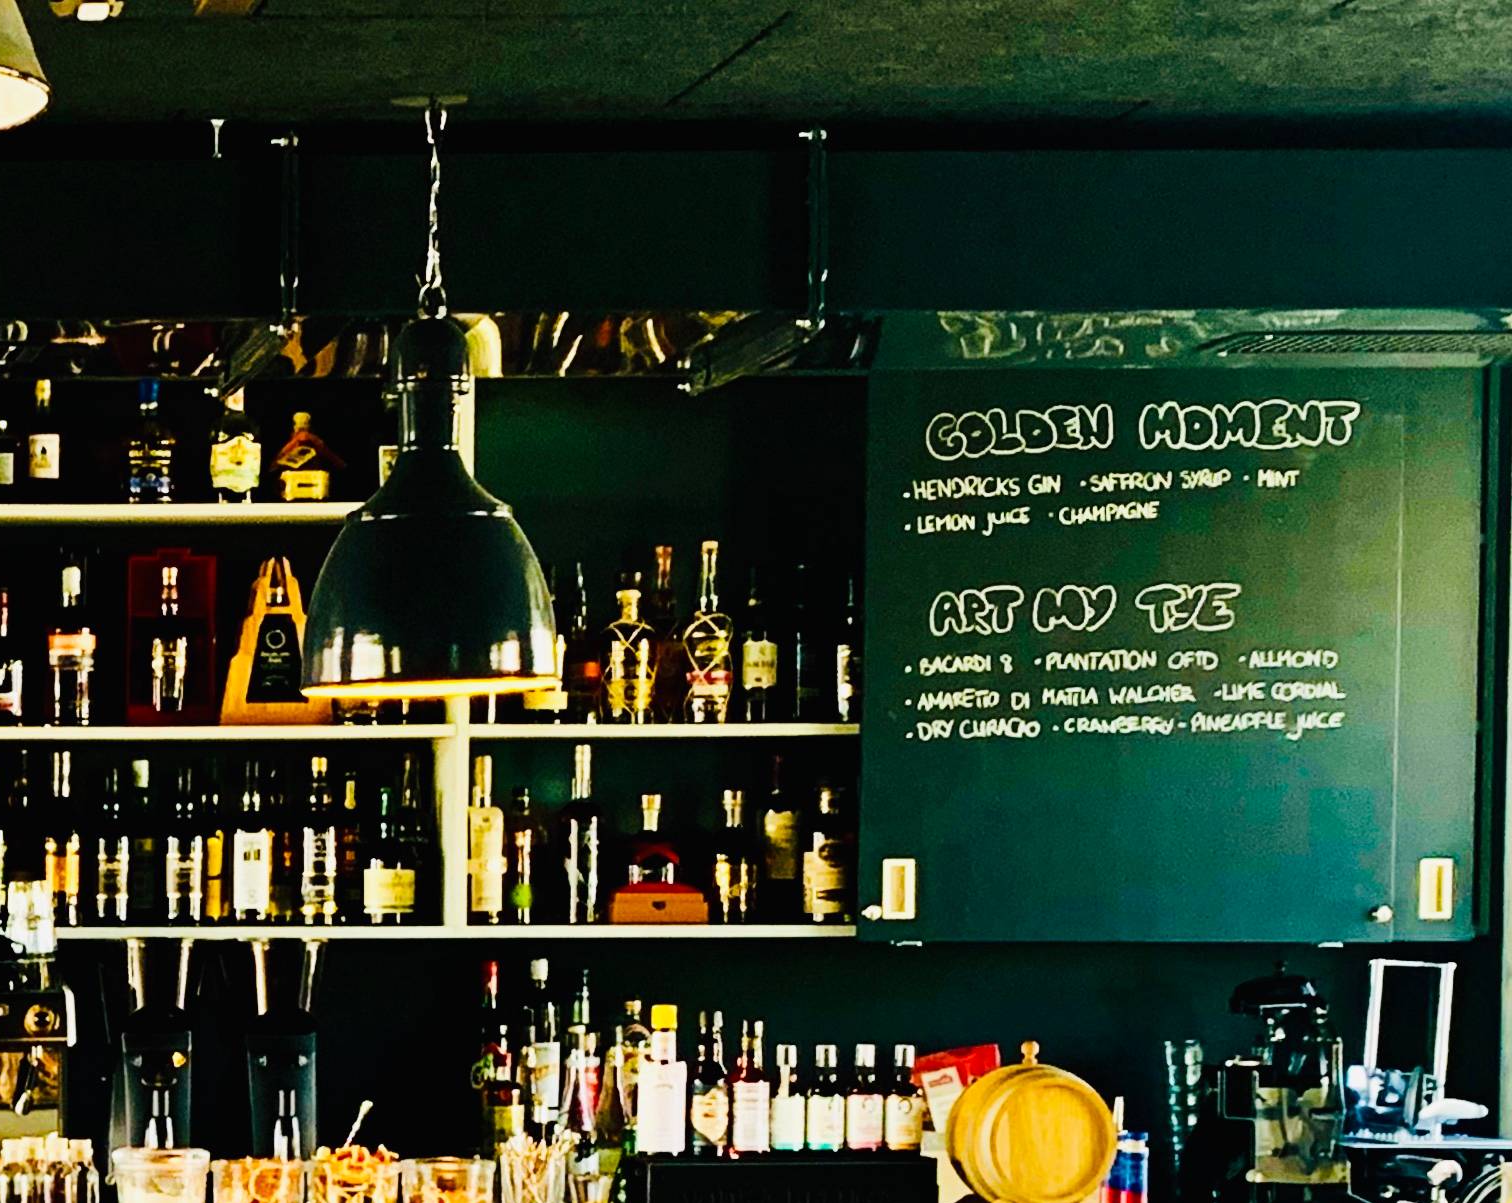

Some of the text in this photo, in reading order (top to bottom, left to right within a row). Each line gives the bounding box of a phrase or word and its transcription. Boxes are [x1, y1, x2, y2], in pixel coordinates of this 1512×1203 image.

[925, 398, 1361, 461] GOLDEN MOMENT
[912, 468, 1300, 501] HENDRICKS GIN SAFFRON SYRUP MINT
[917, 513, 976, 535] LEMON
[1058, 500, 1160, 526] CHAMPAGNE
[929, 584, 1025, 637] ART
[1032, 584, 1117, 633] MY
[919, 654, 992, 677] BACARDI
[999, 653, 1013, 674] 8
[1045, 649, 1158, 672] PLANTATION
[1010, 691, 1031, 711] DI
[1221, 681, 1266, 701] LIME
[1270, 681, 1347, 702] CORDIAL
[916, 719, 955, 742] DRY
[1190, 710, 1287, 733] PINEAPPLE
